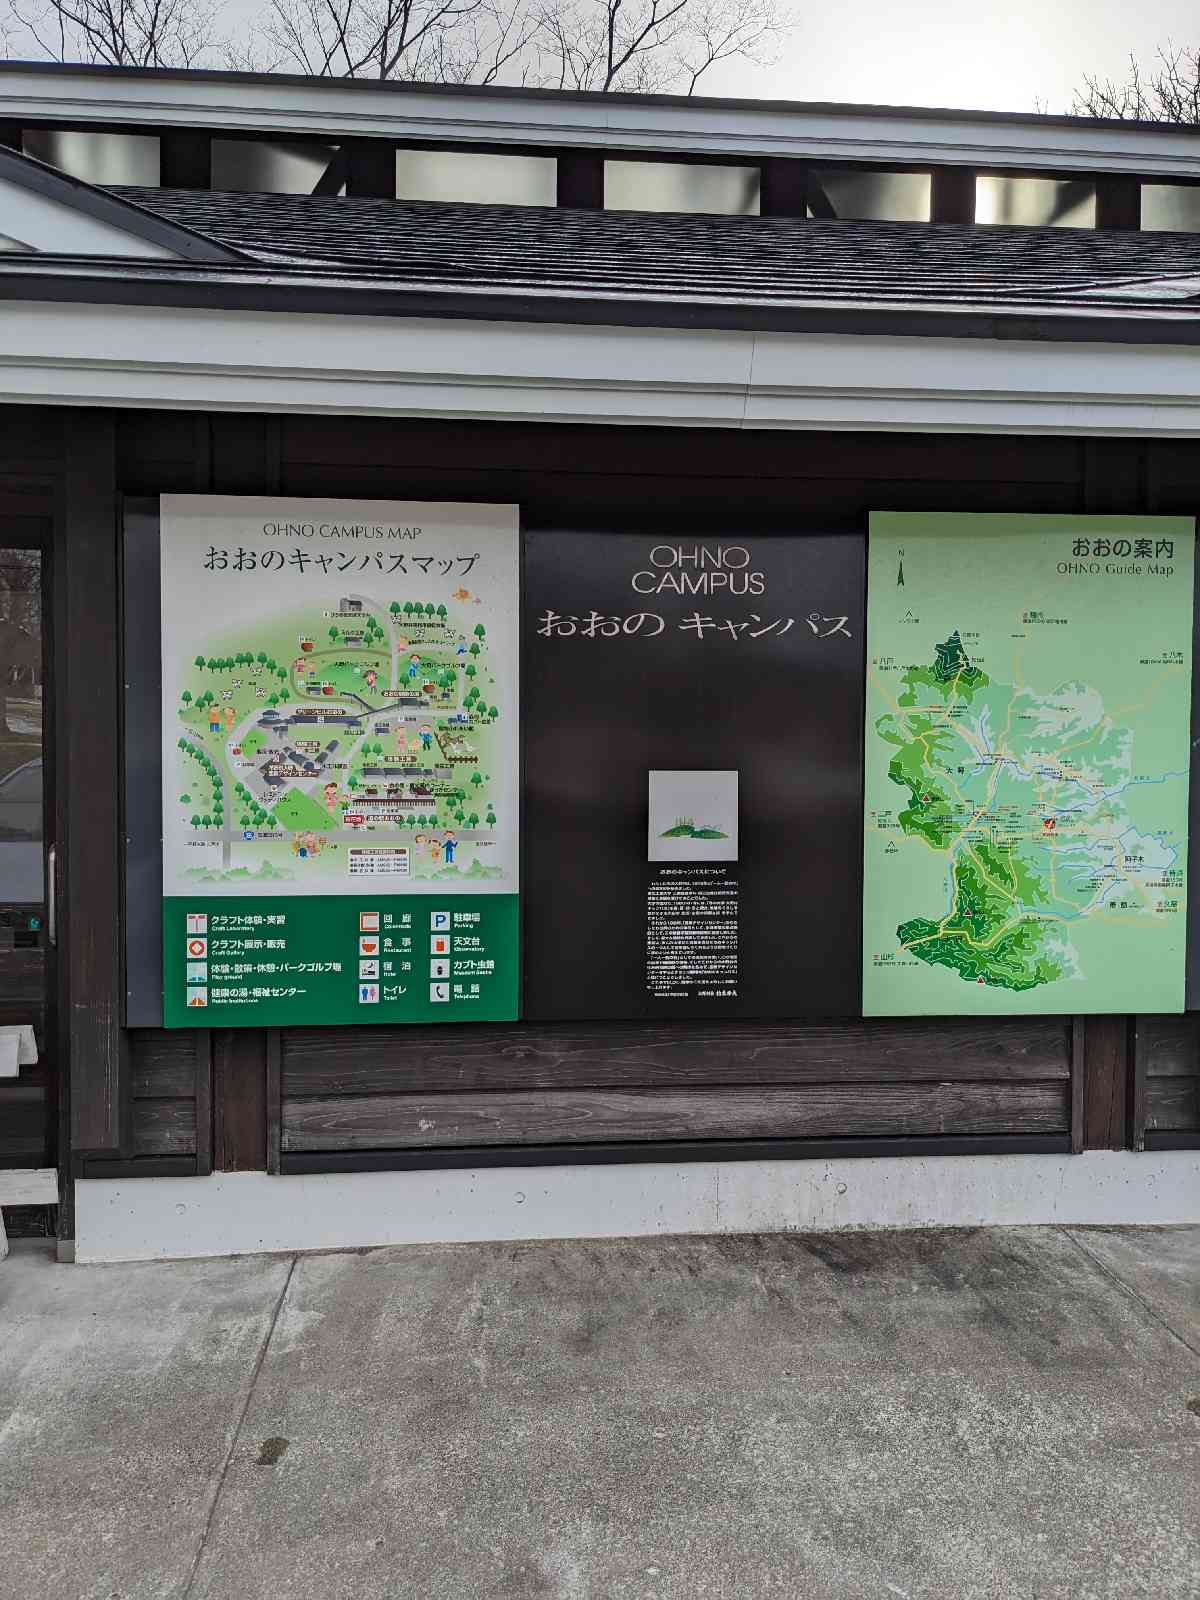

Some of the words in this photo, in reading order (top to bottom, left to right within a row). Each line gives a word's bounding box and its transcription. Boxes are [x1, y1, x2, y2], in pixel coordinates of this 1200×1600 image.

[263, 522, 315, 539] OHNO
[319, 523, 384, 540] CAMPUS
[387, 525, 423, 541] MAP
[649, 545, 751, 568] OHNO
[1072, 538, 1175, 559] おおの案内
[203, 545, 481, 576] おおのキャンパスマップ
[1056, 562, 1101, 575] OHNO
[1105, 563, 1143, 576] Guide
[1147, 564, 1175, 578] Map
[631, 570, 765, 595] CAMPUS
[536, 609, 666, 638] おおの
[678, 612, 853, 641] キャンパス
[453, 936, 481, 947] 天文台
[383, 984, 408, 995] トイレ
